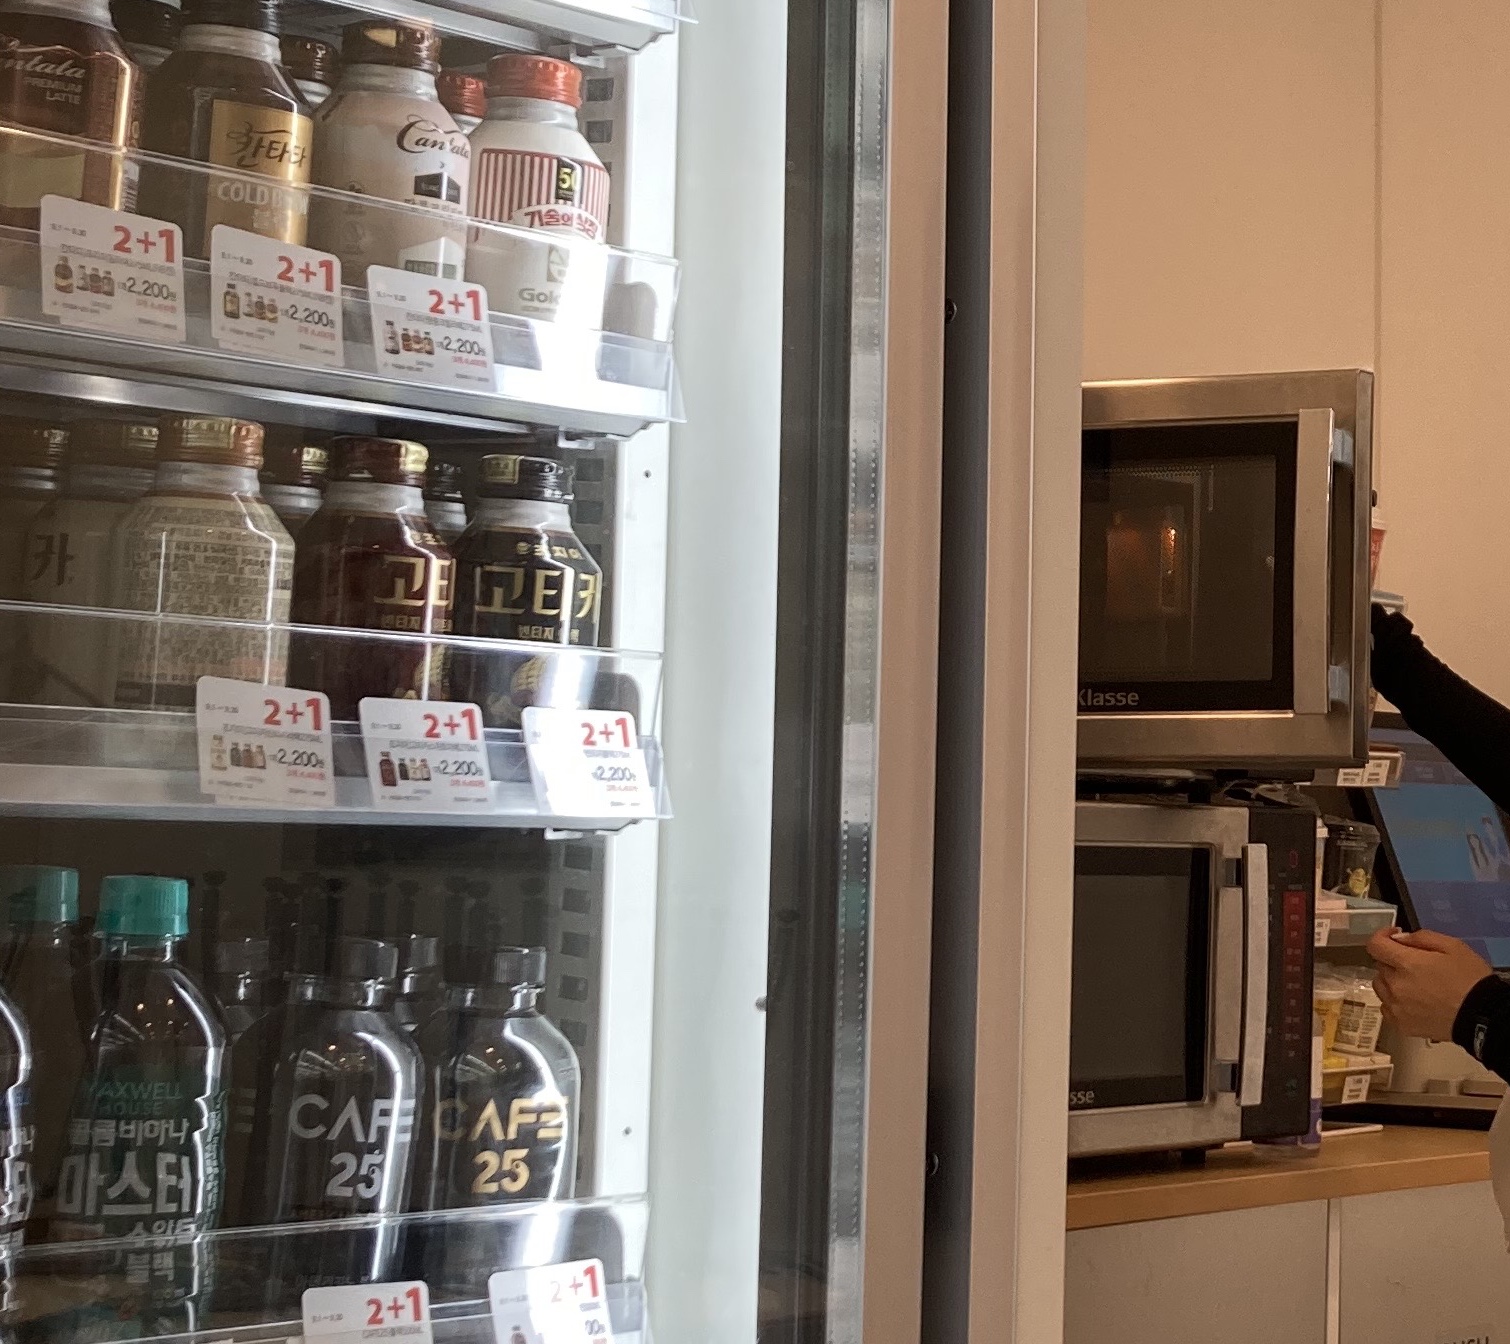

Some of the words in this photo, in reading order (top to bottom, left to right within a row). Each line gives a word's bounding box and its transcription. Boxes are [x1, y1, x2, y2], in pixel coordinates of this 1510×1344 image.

[112, 224, 176, 264] 2+1
[276, 255, 335, 293] 2+1
[427, 288, 483, 322] 2+1
[263, 697, 322, 731] 2+1
[423, 708, 478, 740] 2+1
[580, 717, 631, 748] 2+1
[56, 1151, 193, 1216] 마스터
[325, 1152, 385, 1200] 25
[471, 1147, 530, 1194] 25
[365, 1286, 423, 1325] 2+1
